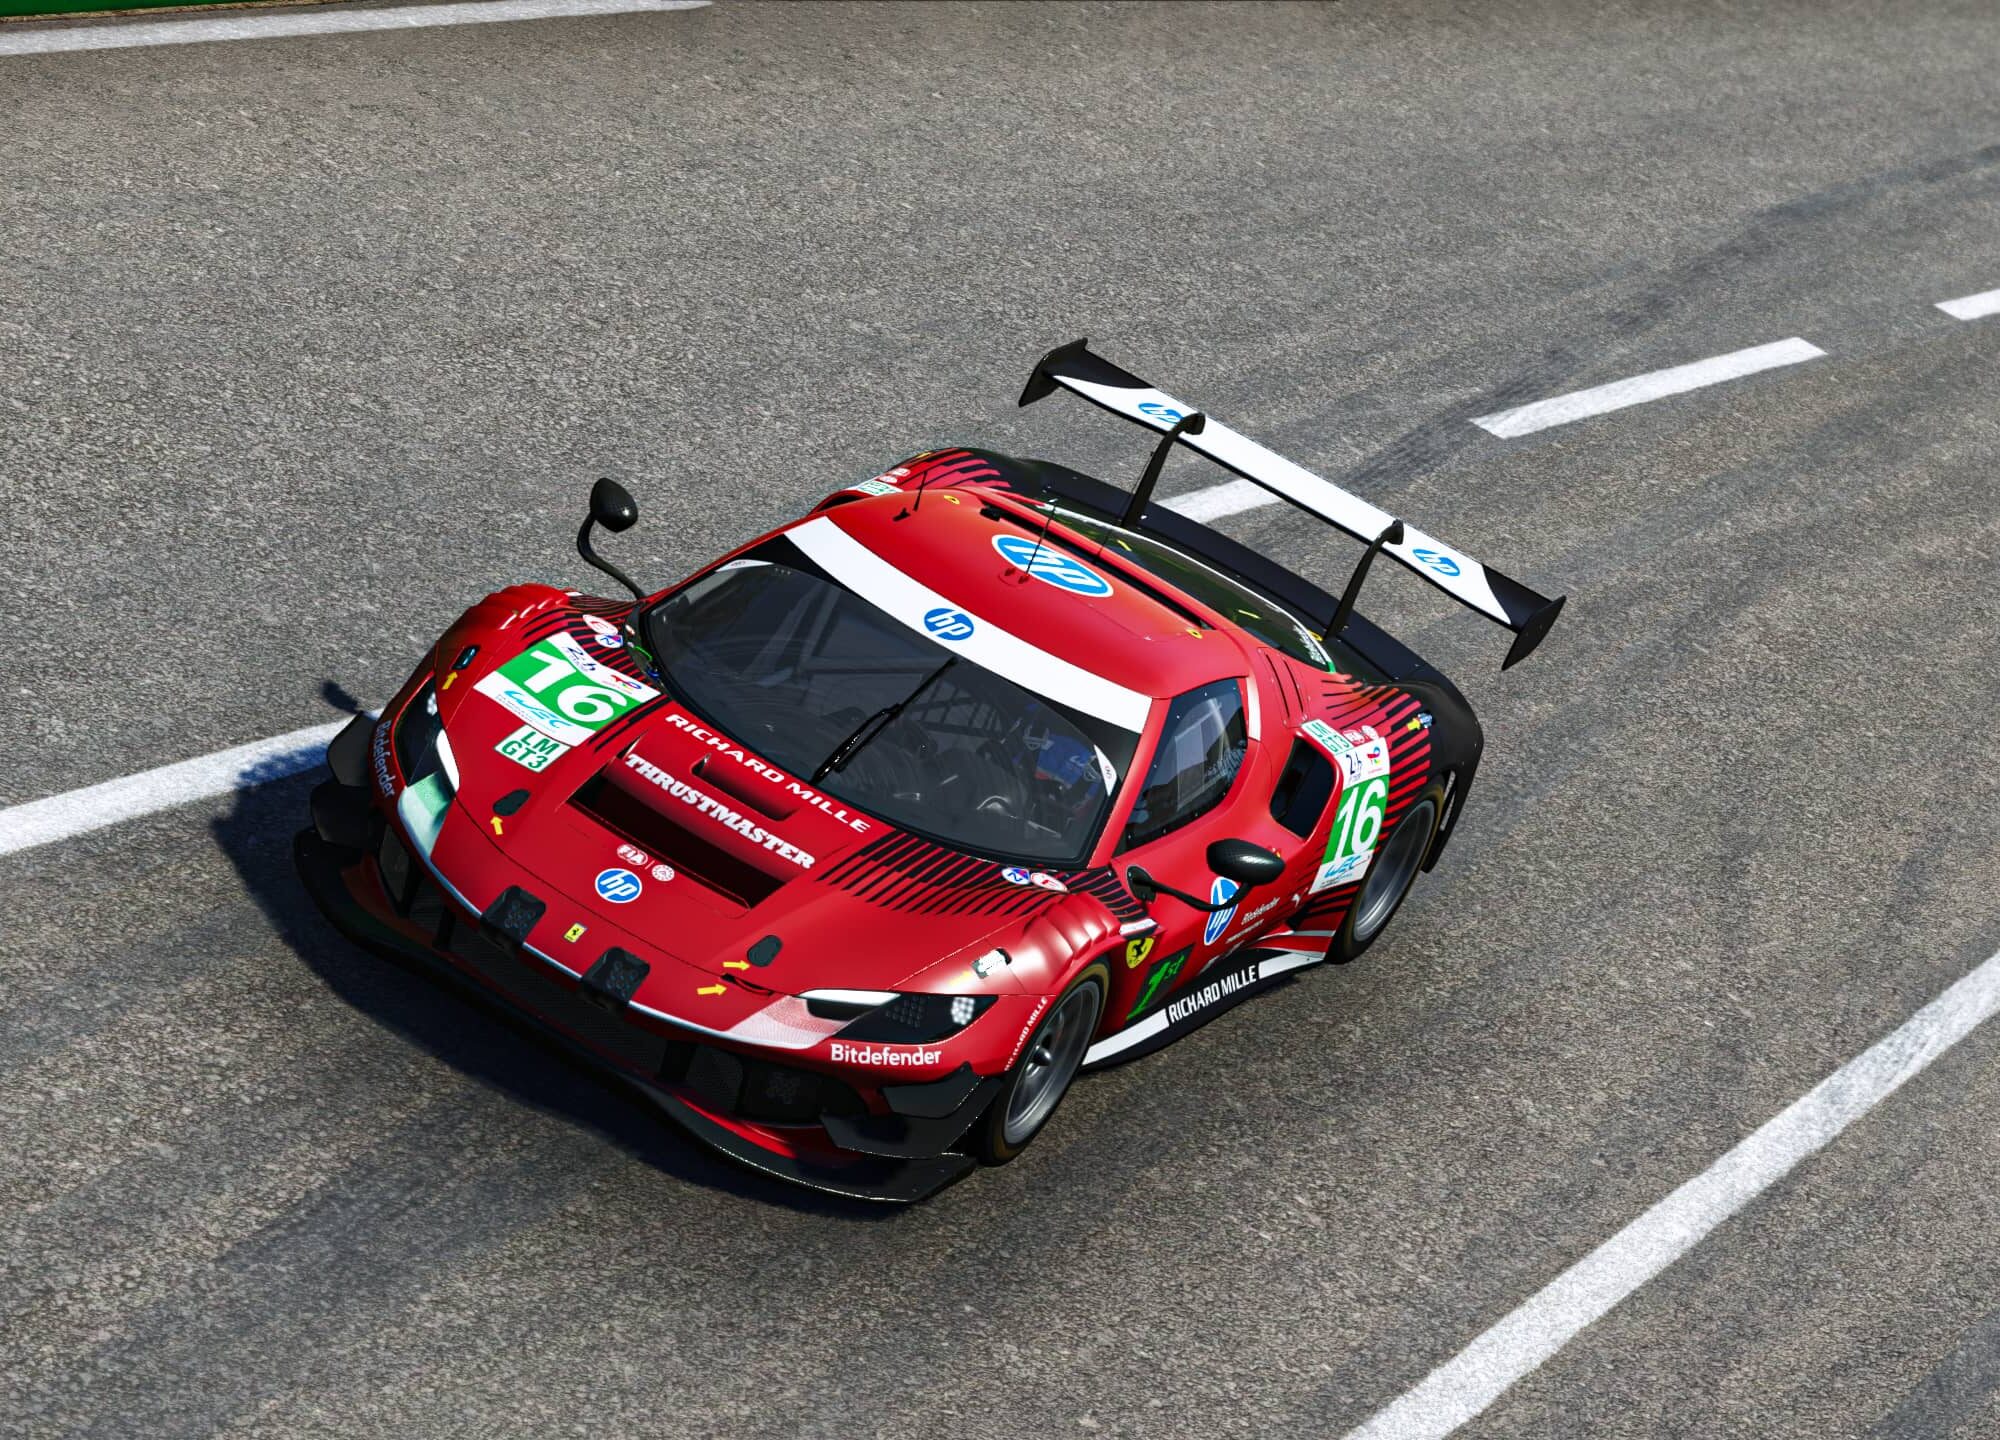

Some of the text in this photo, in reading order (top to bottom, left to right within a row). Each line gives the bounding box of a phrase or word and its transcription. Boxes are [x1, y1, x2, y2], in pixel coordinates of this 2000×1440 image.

[996, 539, 1108, 593] hp
[924, 607, 974, 640] hp
[523, 649, 628, 722] 16
[501, 740, 548, 769] GT3
[520, 731, 560, 755] LM
[665, 714, 871, 833] RICHARD MILLE
[625, 754, 816, 869] THRUSTMASTER
[1336, 778, 1386, 862] 16
[597, 869, 640, 902] hp
[1168, 964, 1257, 1024] RICHARD MILLE
[831, 1043, 942, 1066] Bitdefender
